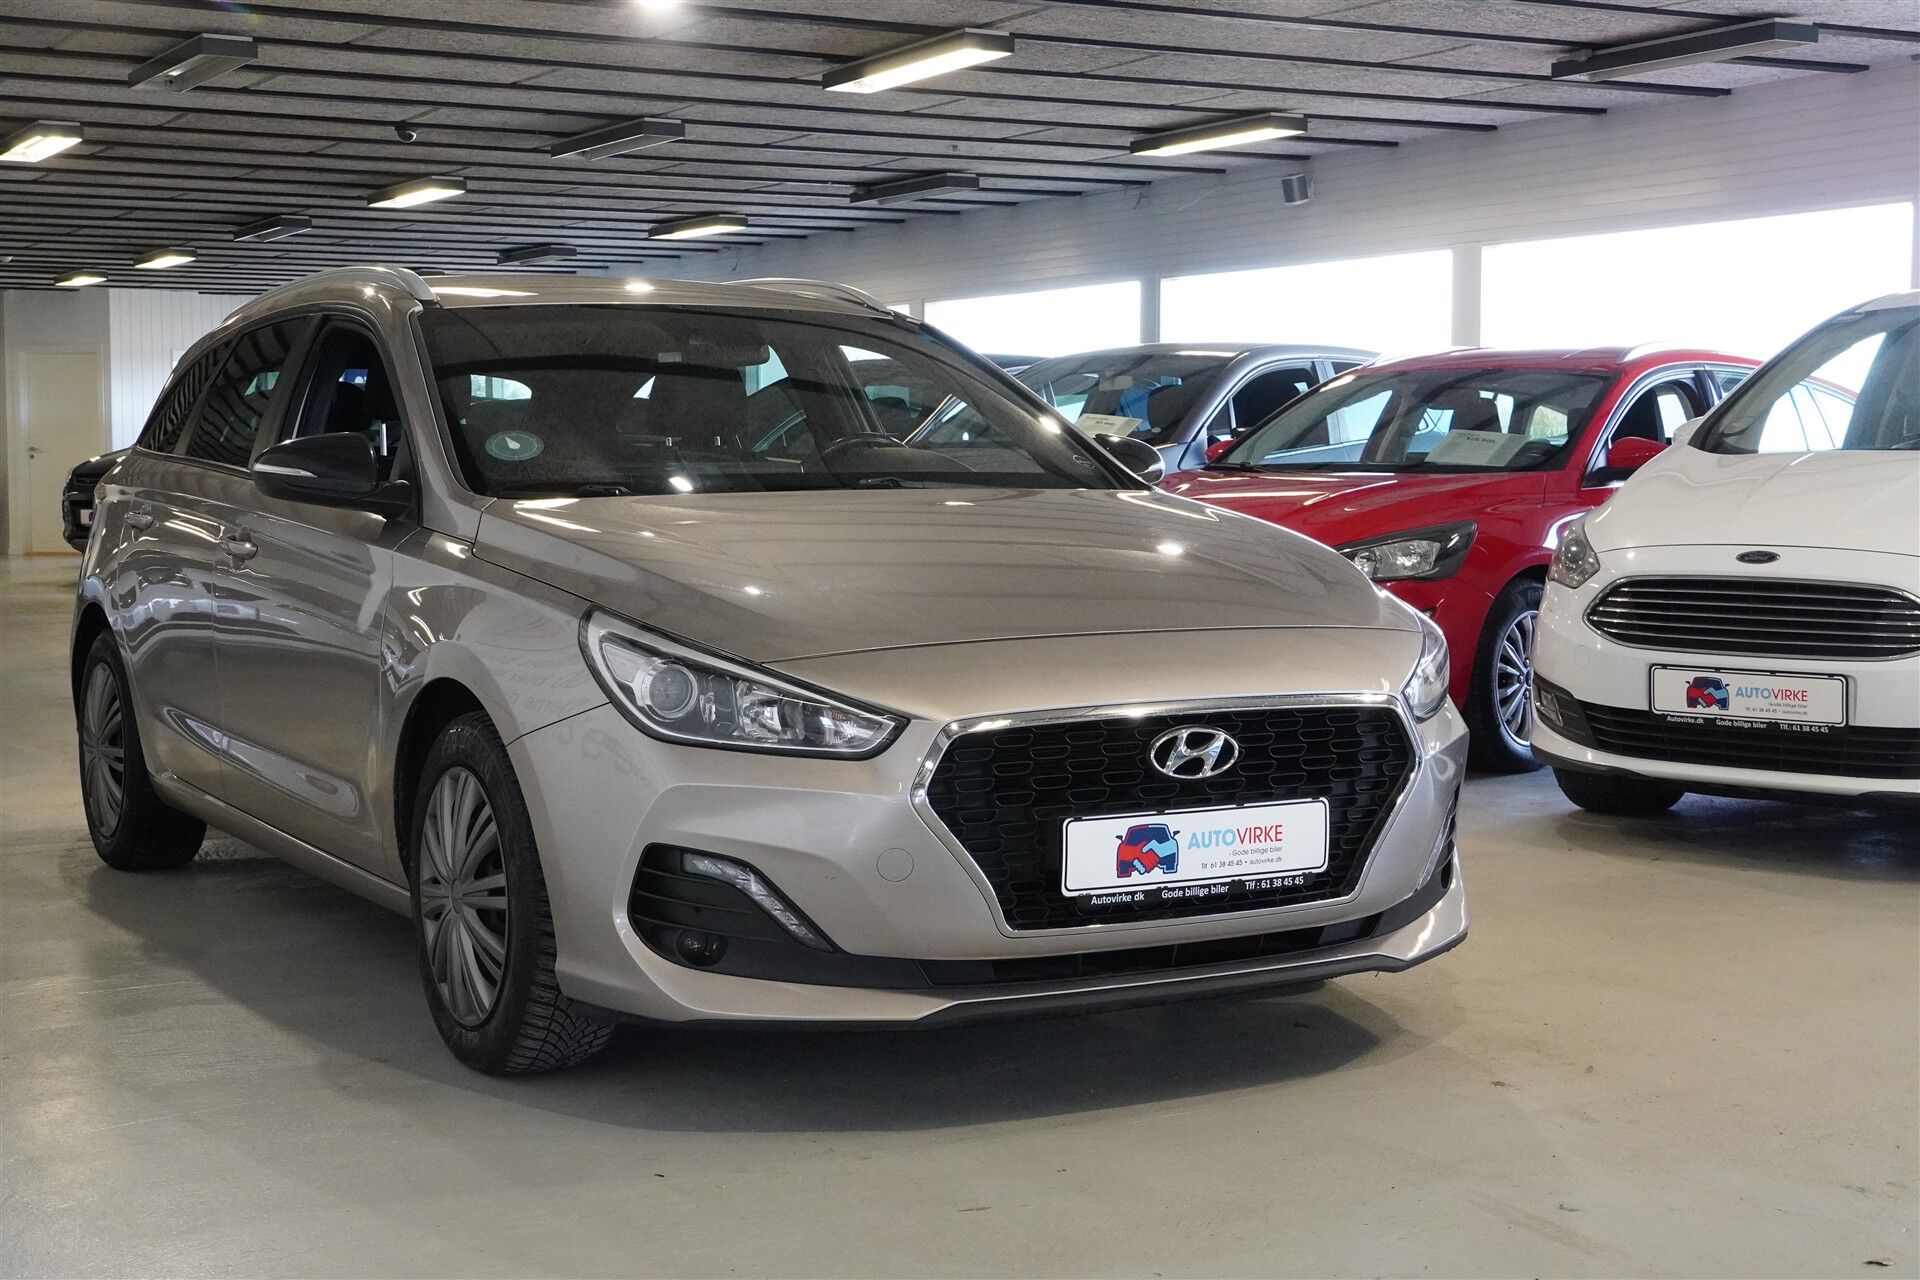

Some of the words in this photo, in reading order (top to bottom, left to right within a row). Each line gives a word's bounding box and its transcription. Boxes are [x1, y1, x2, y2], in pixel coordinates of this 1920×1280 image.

[1735, 686, 1808, 702] AUTOVIRKE
[1667, 715, 1705, 724] Autovirke.dk
[1733, 720, 1752, 729] billige
[1752, 721, 1767, 729] biler
[1187, 824, 1283, 850] AUTOVIRKE
[1231, 848, 1250, 857] Gode
[1250, 846, 1269, 856] billige
[1269, 846, 1283, 854] biler
[1235, 859, 1243, 867] 45
[1261, 879, 1271, 889] 61
[1272, 878, 1282, 888] 38
[1283, 877, 1293, 887] 45
[1294, 876, 1304, 886] 45
[1161, 888, 1184, 899] Gode
[1184, 885, 1210, 897] billige
[1210, 883, 1230, 894] biler
